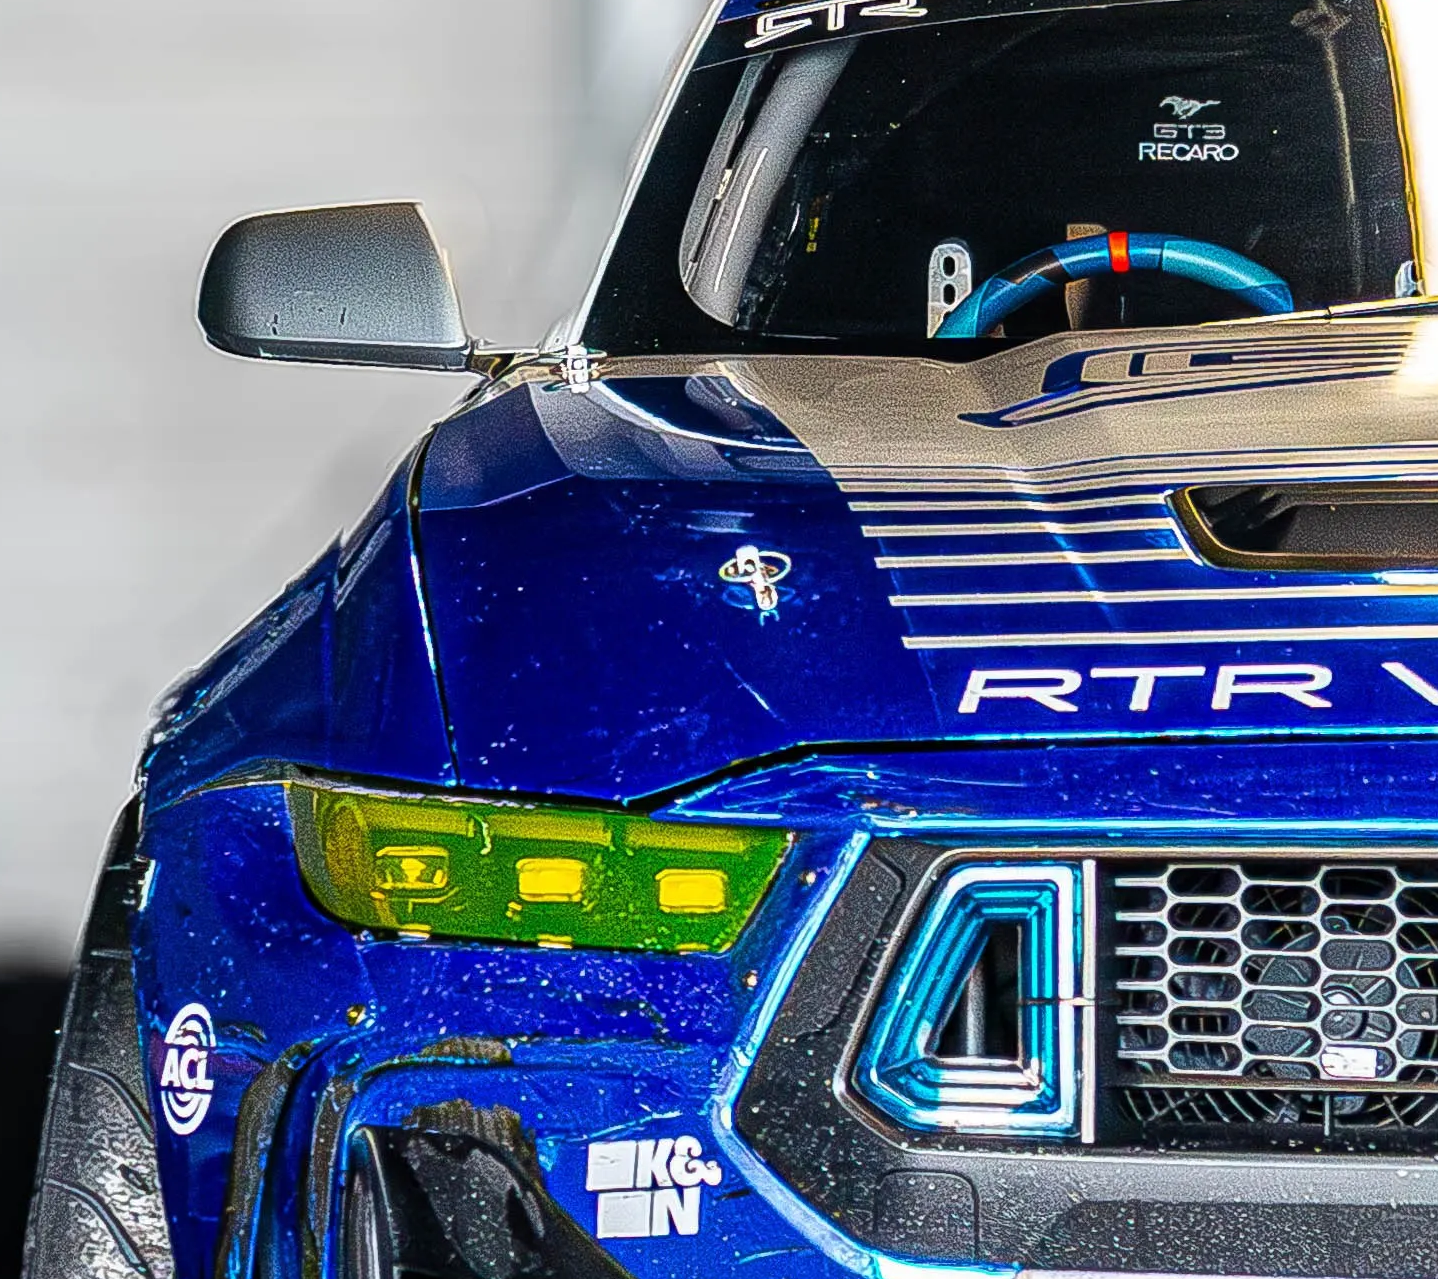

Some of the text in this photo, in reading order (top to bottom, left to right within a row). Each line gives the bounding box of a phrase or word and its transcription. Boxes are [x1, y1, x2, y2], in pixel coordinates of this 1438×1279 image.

[1153, 123, 1226, 139] GT3
[1138, 142, 1239, 162] RECARO
[956, 665, 1339, 716] RTR
[161, 1048, 215, 1091] ACL
